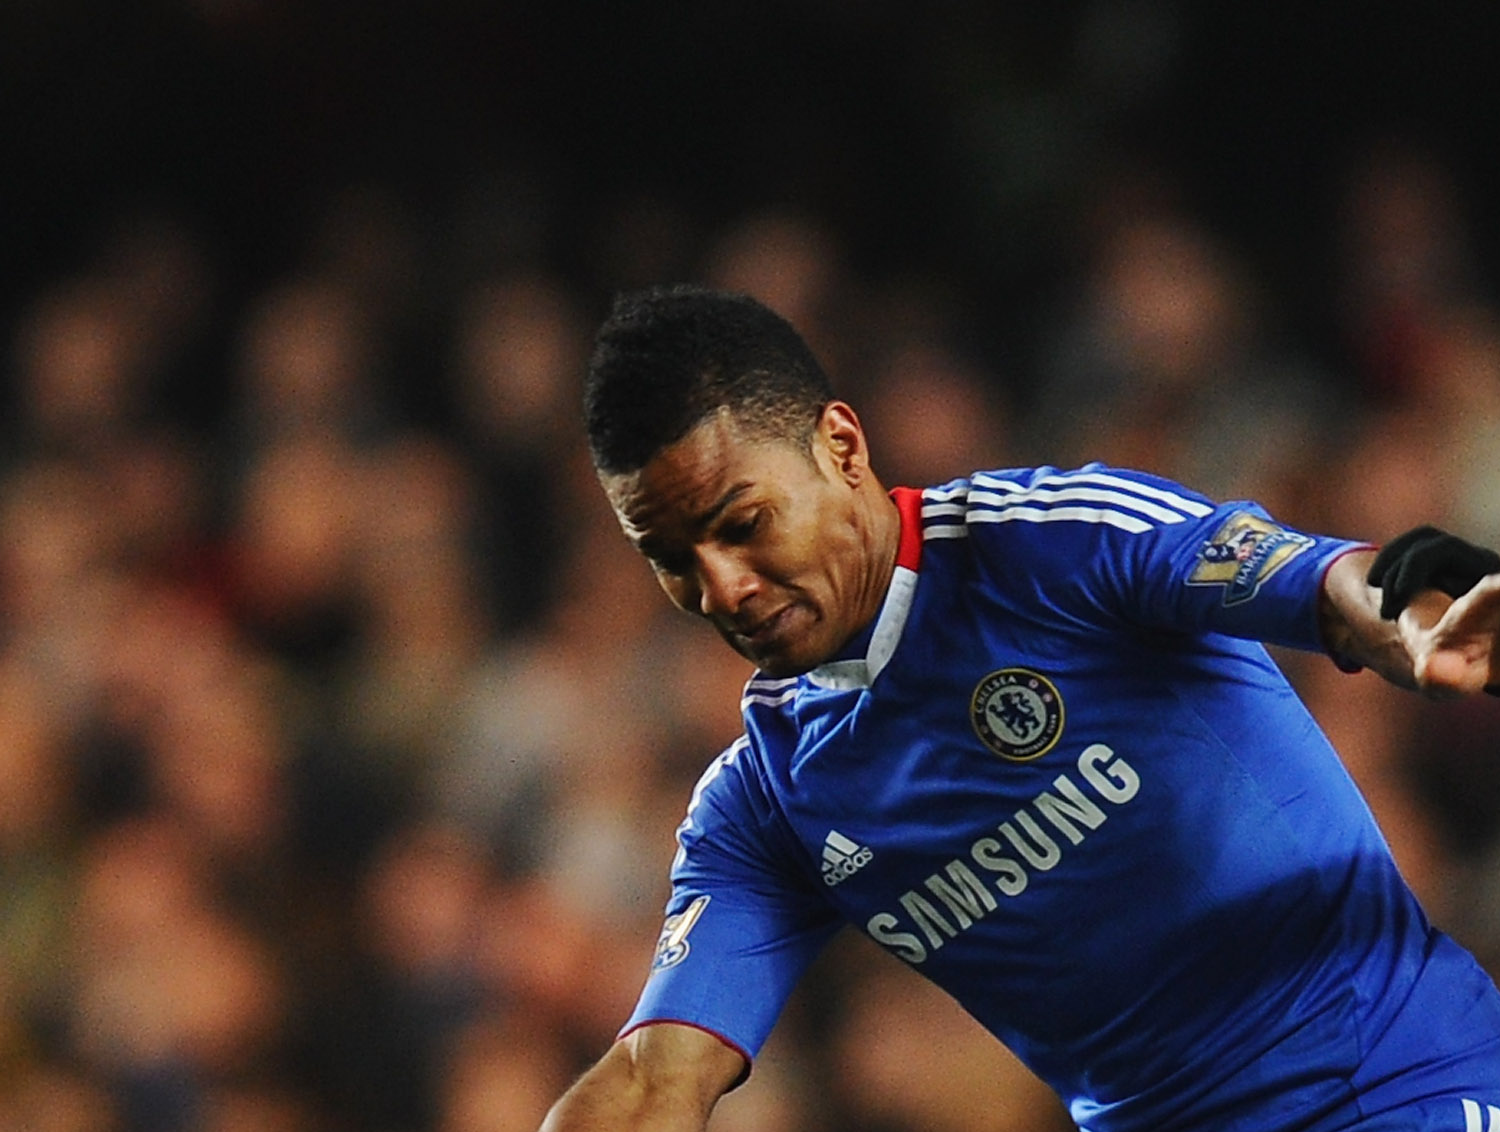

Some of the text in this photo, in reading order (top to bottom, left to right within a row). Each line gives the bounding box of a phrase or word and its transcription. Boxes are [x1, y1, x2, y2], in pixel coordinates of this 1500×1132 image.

[975, 675, 1016, 713] CHELSEA
[823, 846, 874, 887] adidas
[866, 743, 1141, 964] SAMSUNG
